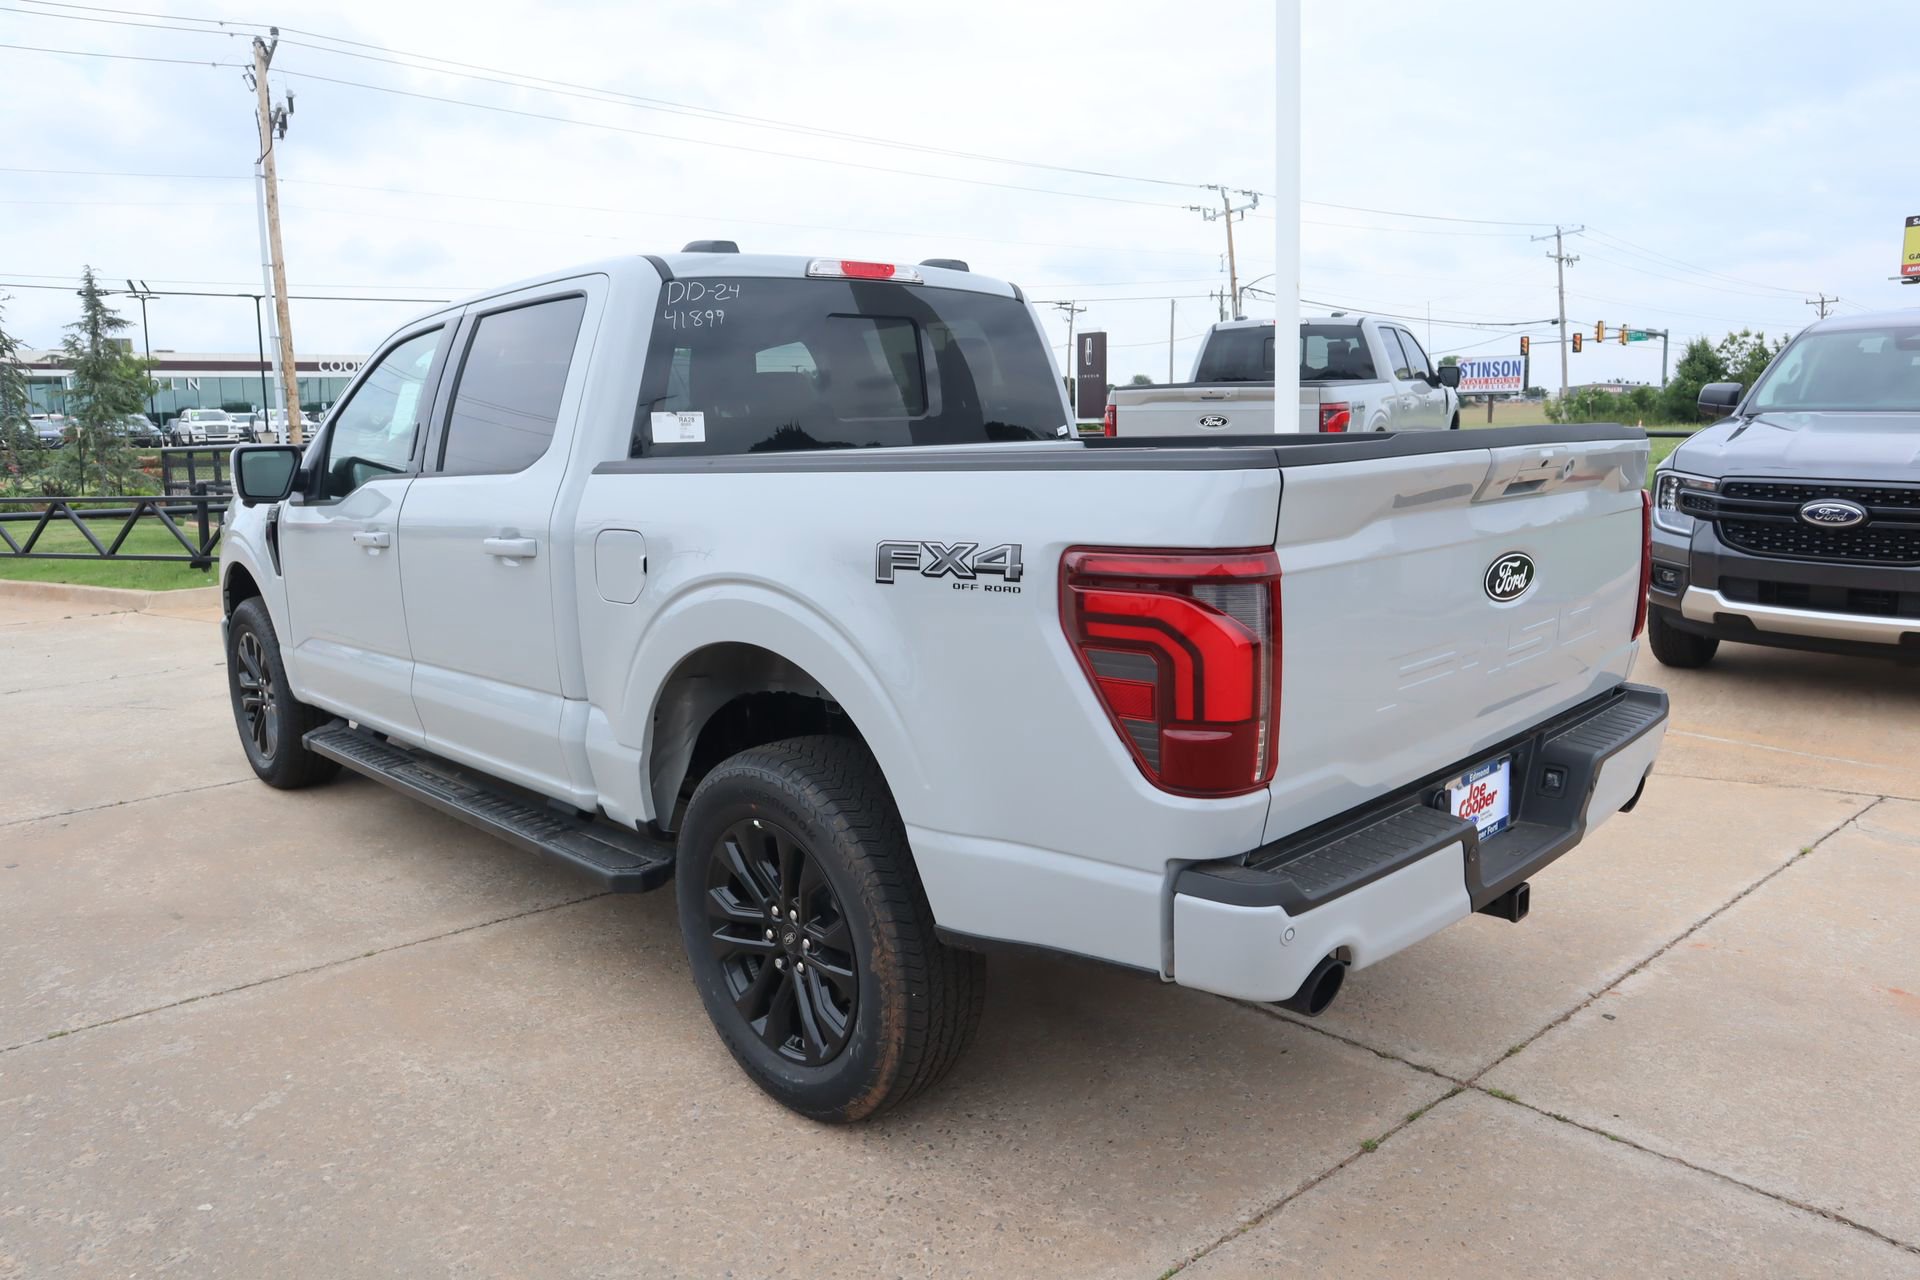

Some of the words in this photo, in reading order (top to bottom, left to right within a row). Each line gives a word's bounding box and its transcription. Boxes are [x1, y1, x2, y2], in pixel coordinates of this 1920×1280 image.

[667, 281, 740, 306] DD-24
[664, 309, 725, 330] 41899
[1460, 361, 1521, 378] STINSON
[1204, 417, 1223, 426] Ford
[1815, 507, 1848, 521] Ford
[875, 540, 1024, 584] FX4
[1495, 560, 1528, 594] Ford
[952, 582, 979, 591] OFF
[984, 585, 1021, 594] ROAD
[1469, 766, 1490, 782] Edmond
[1469, 782, 1487, 801] Joe
[1459, 789, 1498, 820] Cooper
[1487, 821, 1499, 835] Ford
